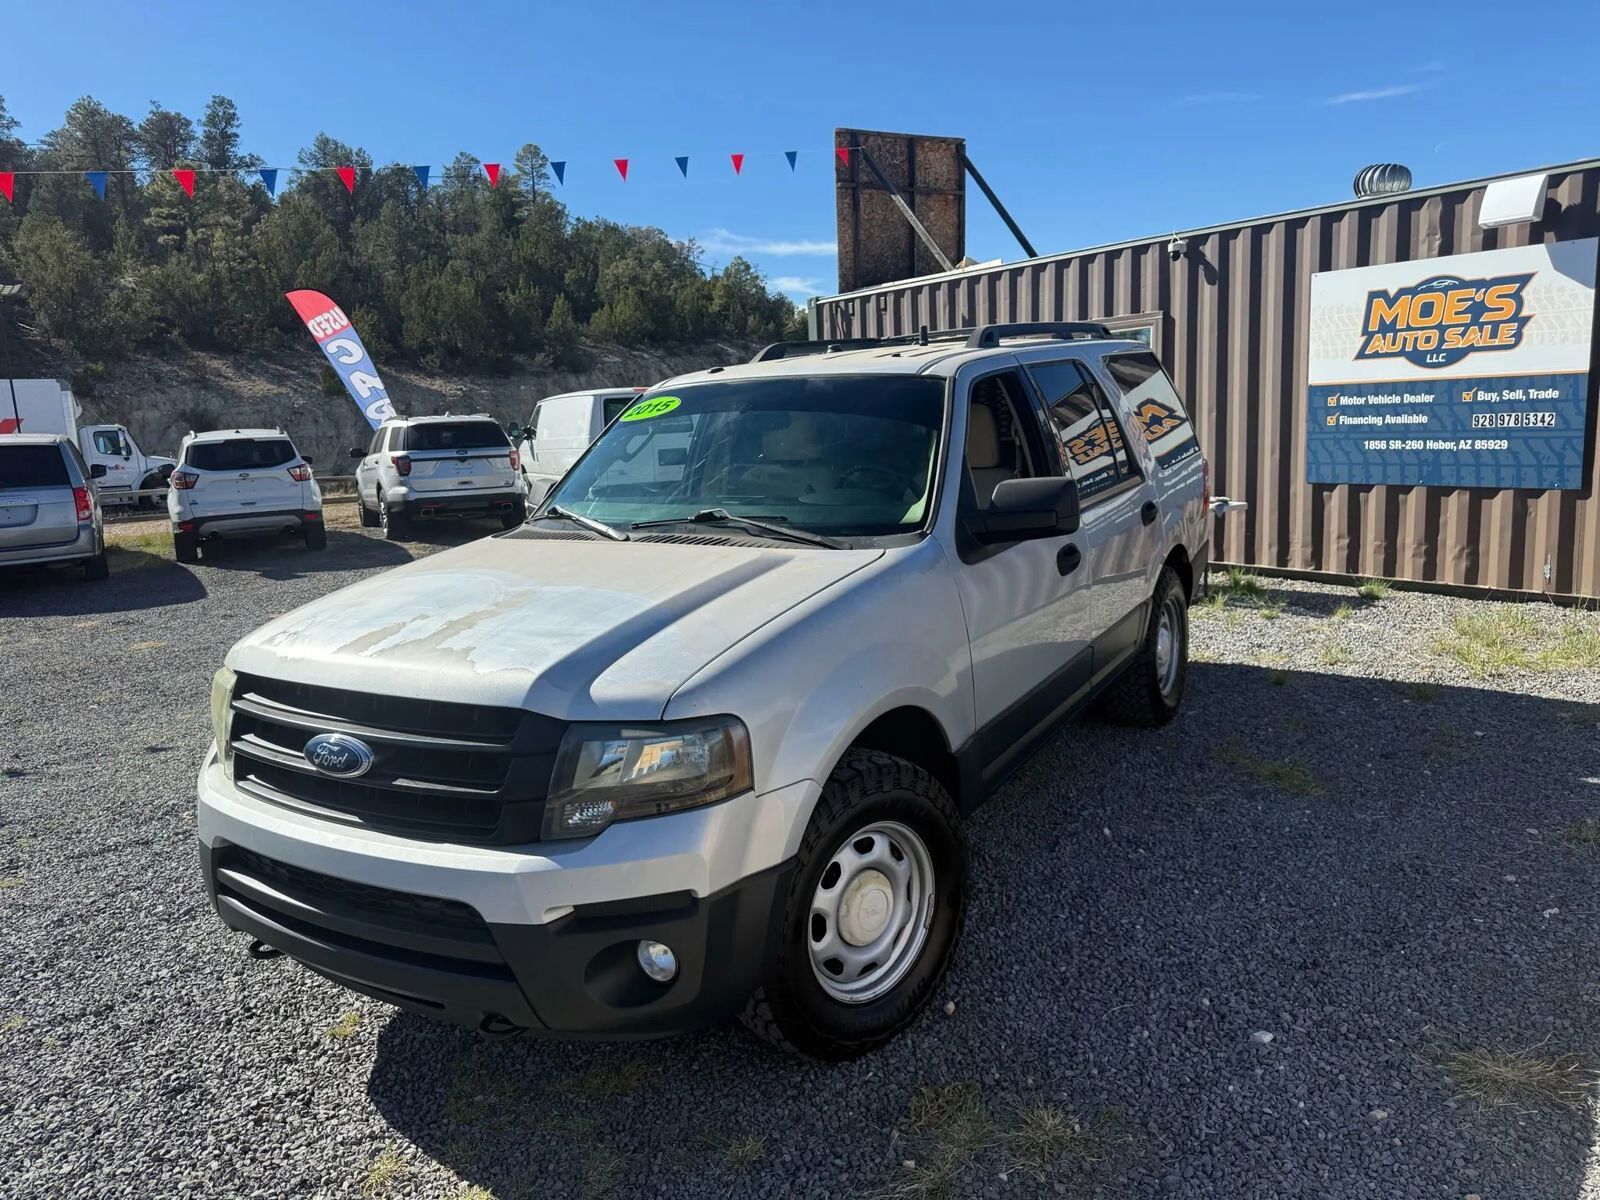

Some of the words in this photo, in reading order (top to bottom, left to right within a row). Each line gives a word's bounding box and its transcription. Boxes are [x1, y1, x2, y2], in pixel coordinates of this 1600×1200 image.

[1368, 284, 1520, 331] MOE'S
[1365, 330, 1439, 354] AUTO
[1441, 323, 1518, 349] SALE
[1426, 353, 1446, 363] LLC
[1340, 396, 1366, 405] Motor
[1368, 394, 1400, 405] Vehicle
[1403, 393, 1434, 403] Dealer
[1477, 391, 1500, 402] Buy,
[1502, 390, 1526, 401] Sell,
[1528, 389, 1559, 399] Trade
[624, 400, 677, 419] 2015
[1339, 415, 1383, 426] Financing
[1385, 414, 1428, 424] Available
[1473, 414, 1495, 427] 928
[1499, 413, 1520, 426] 978
[1524, 413, 1555, 426] 5342
[1364, 440, 1387, 450] 1856
[1389, 440, 1424, 450] SR-260
[1426, 440, 1457, 451] Heber,
[1459, 440, 1472, 450] AZ
[1474, 440, 1508, 450] 85929
[313, 742, 349, 768] Ford
